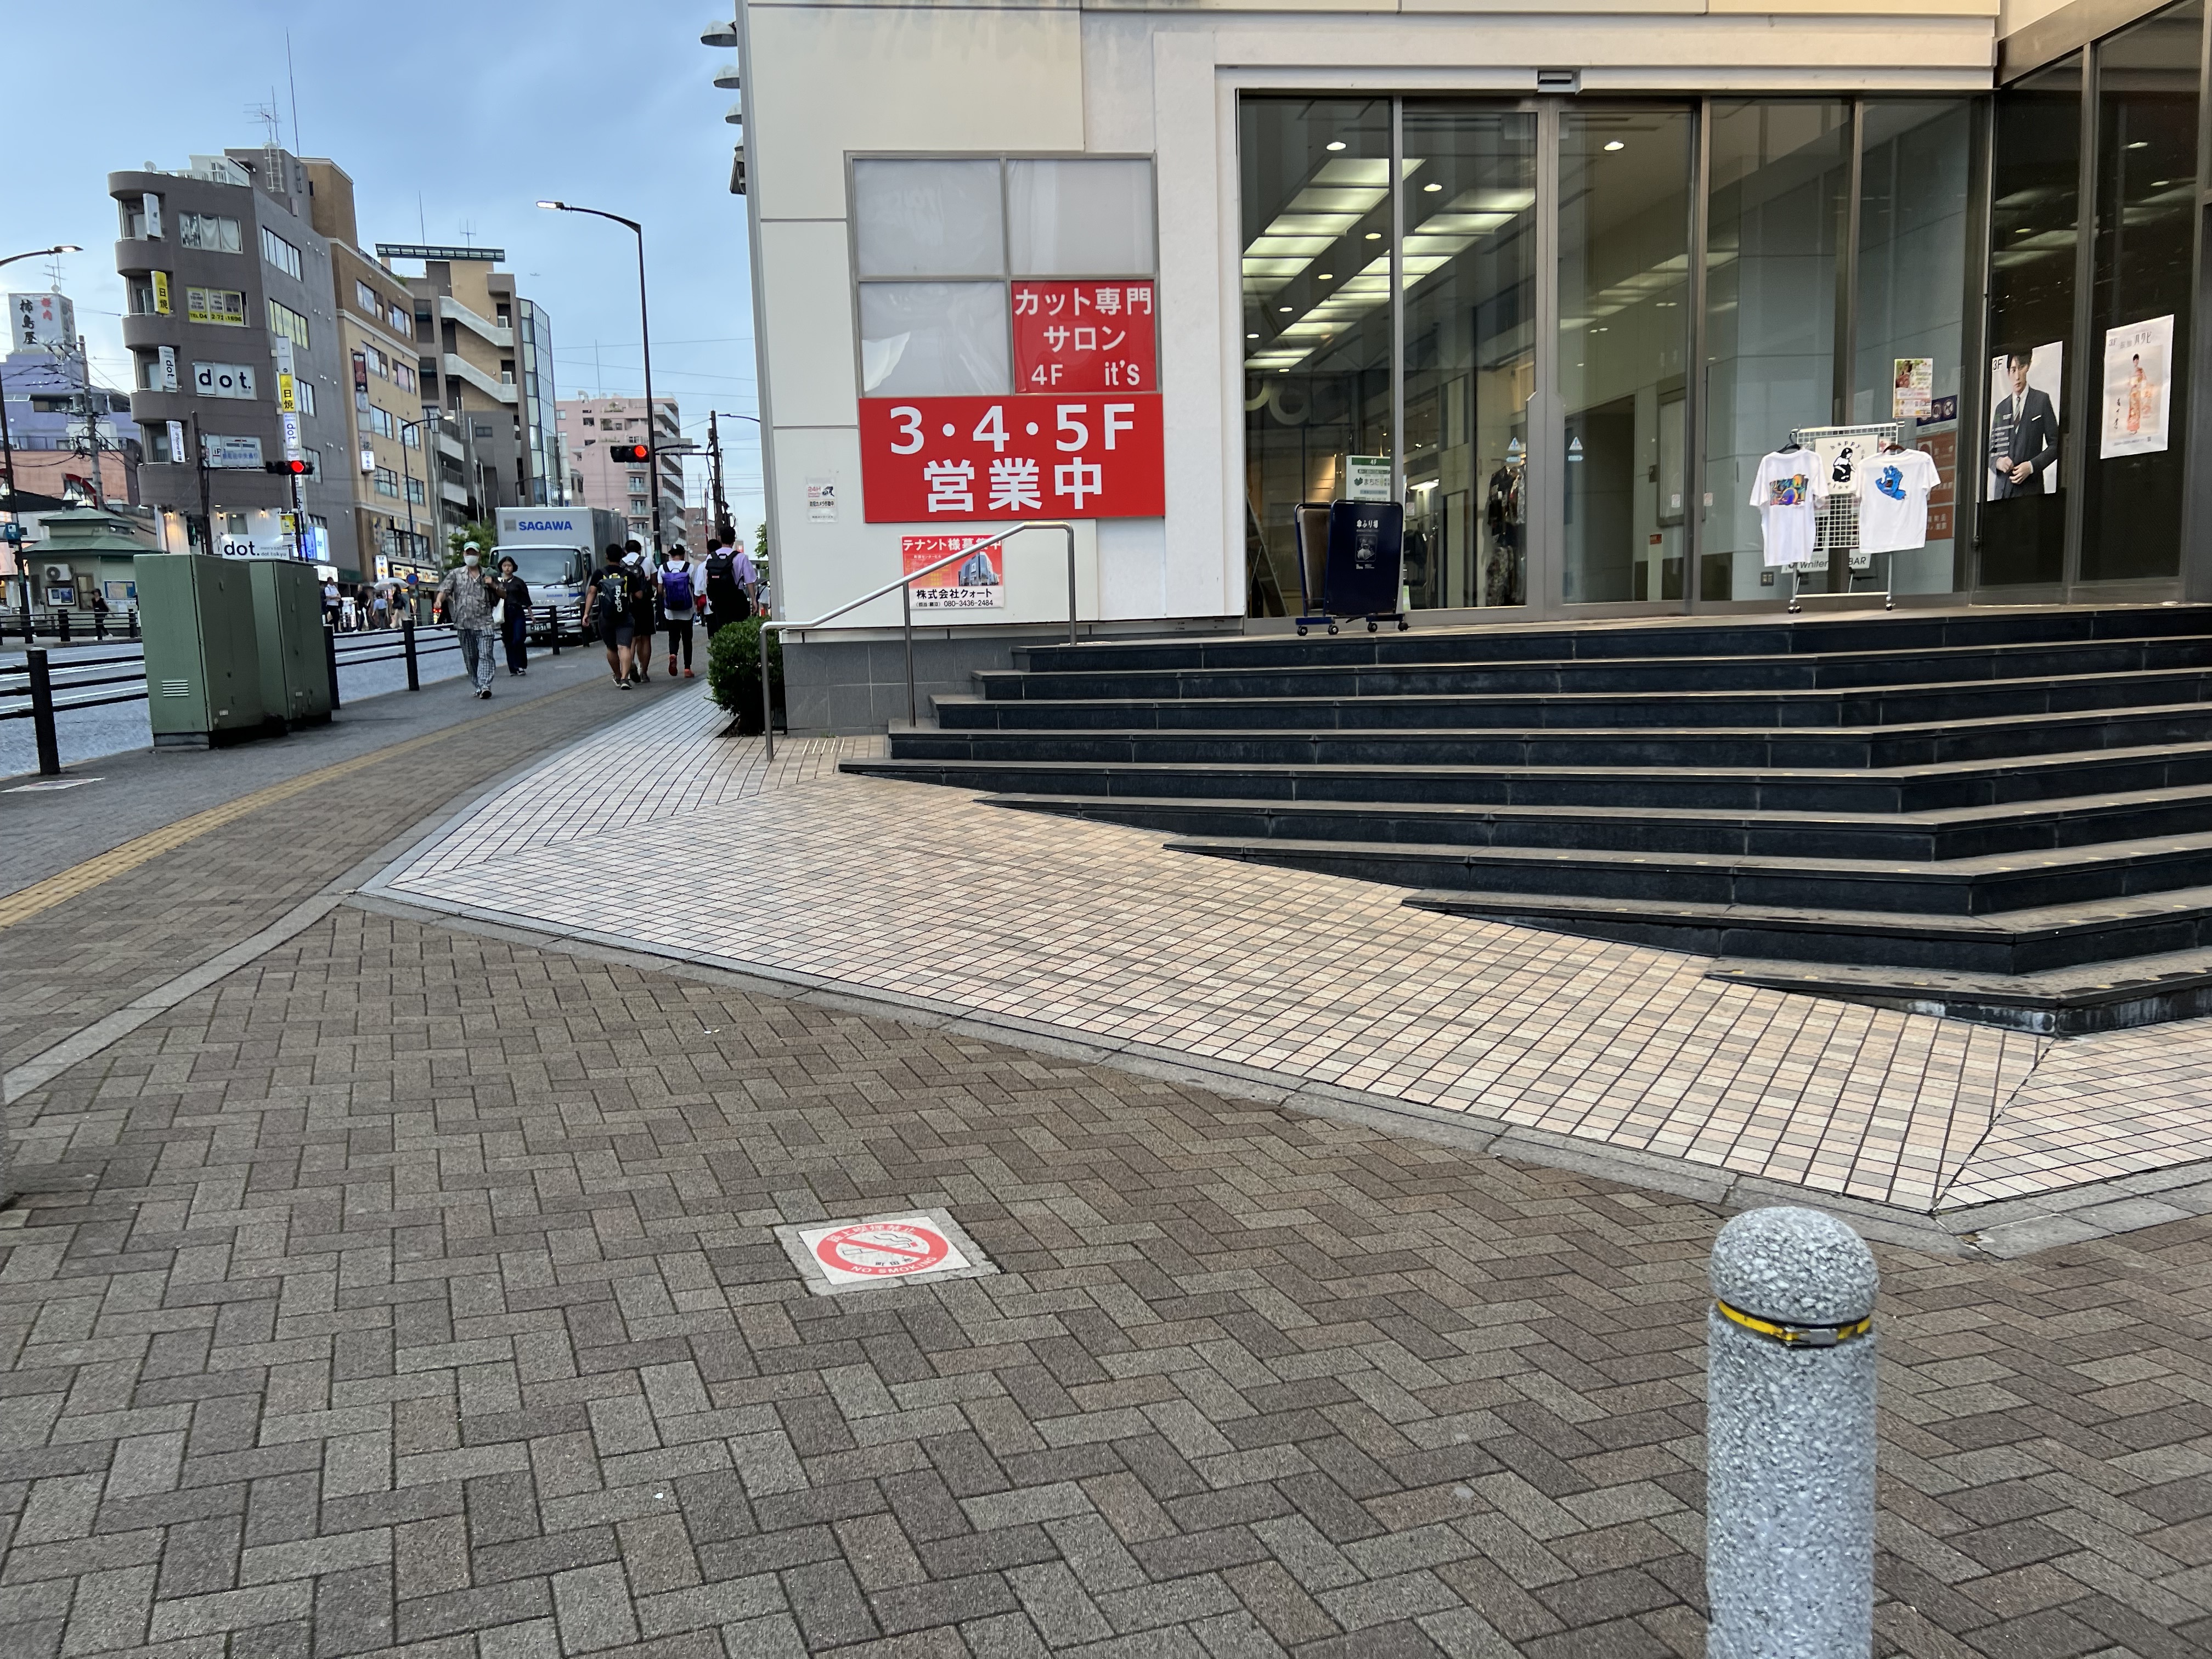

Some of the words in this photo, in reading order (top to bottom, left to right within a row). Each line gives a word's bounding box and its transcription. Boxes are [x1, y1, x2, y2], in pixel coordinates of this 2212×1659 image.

[1014, 287, 1152, 316] カット専門
[1043, 325, 1126, 352] サロン
[1031, 363, 1063, 386] 4F
[1104, 360, 1140, 386] it's
[1993, 359, 2003, 370] 3F
[199, 369, 251, 388] dot.
[284, 390, 294, 409] 日焼
[923, 457, 1102, 512] 営業中
[518, 521, 573, 531] SAGAWA
[224, 541, 260, 556] dot.
[916, 588, 992, 600] 株式会社クォート
[878, 1256, 938, 1273] SMOKING
